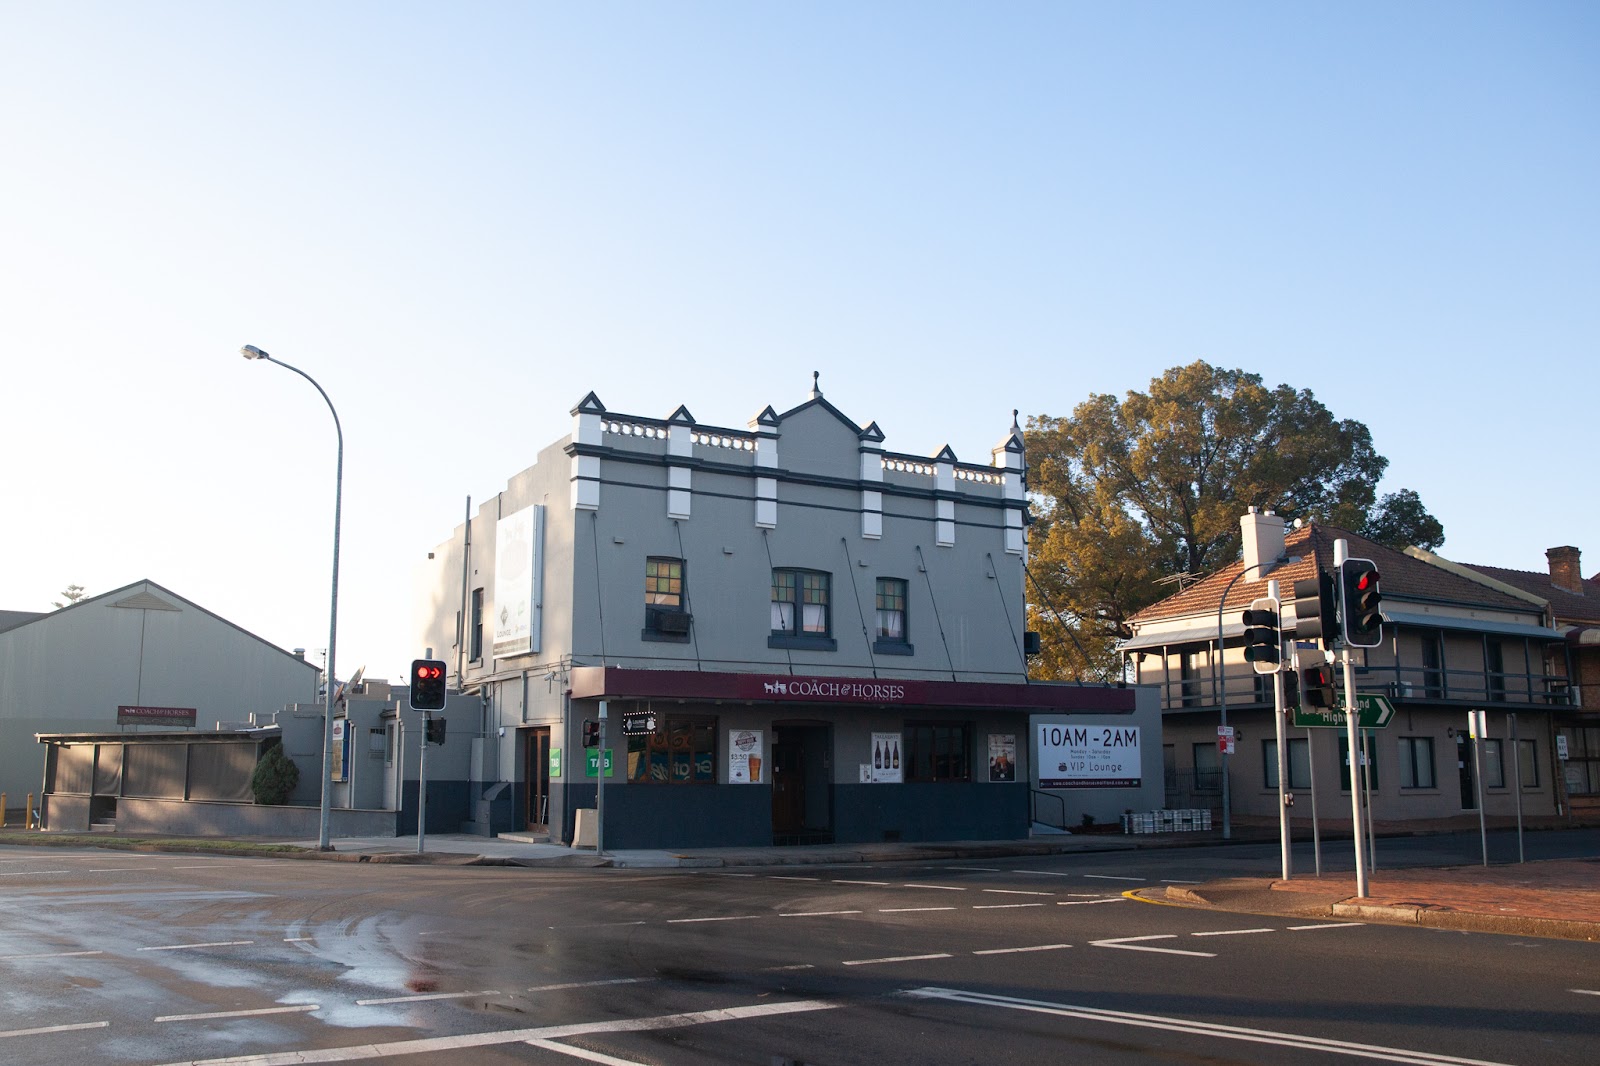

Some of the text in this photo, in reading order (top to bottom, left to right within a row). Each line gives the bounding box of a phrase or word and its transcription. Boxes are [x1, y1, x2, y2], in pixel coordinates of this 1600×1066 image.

[789, 681, 905, 699] COACH & HORSES
[1043, 728, 1087, 747] 10AM
[1103, 729, 1137, 747] 2AM
[551, 758, 559, 768] TAB
[1070, 761, 1122, 773] VIP Lounge
